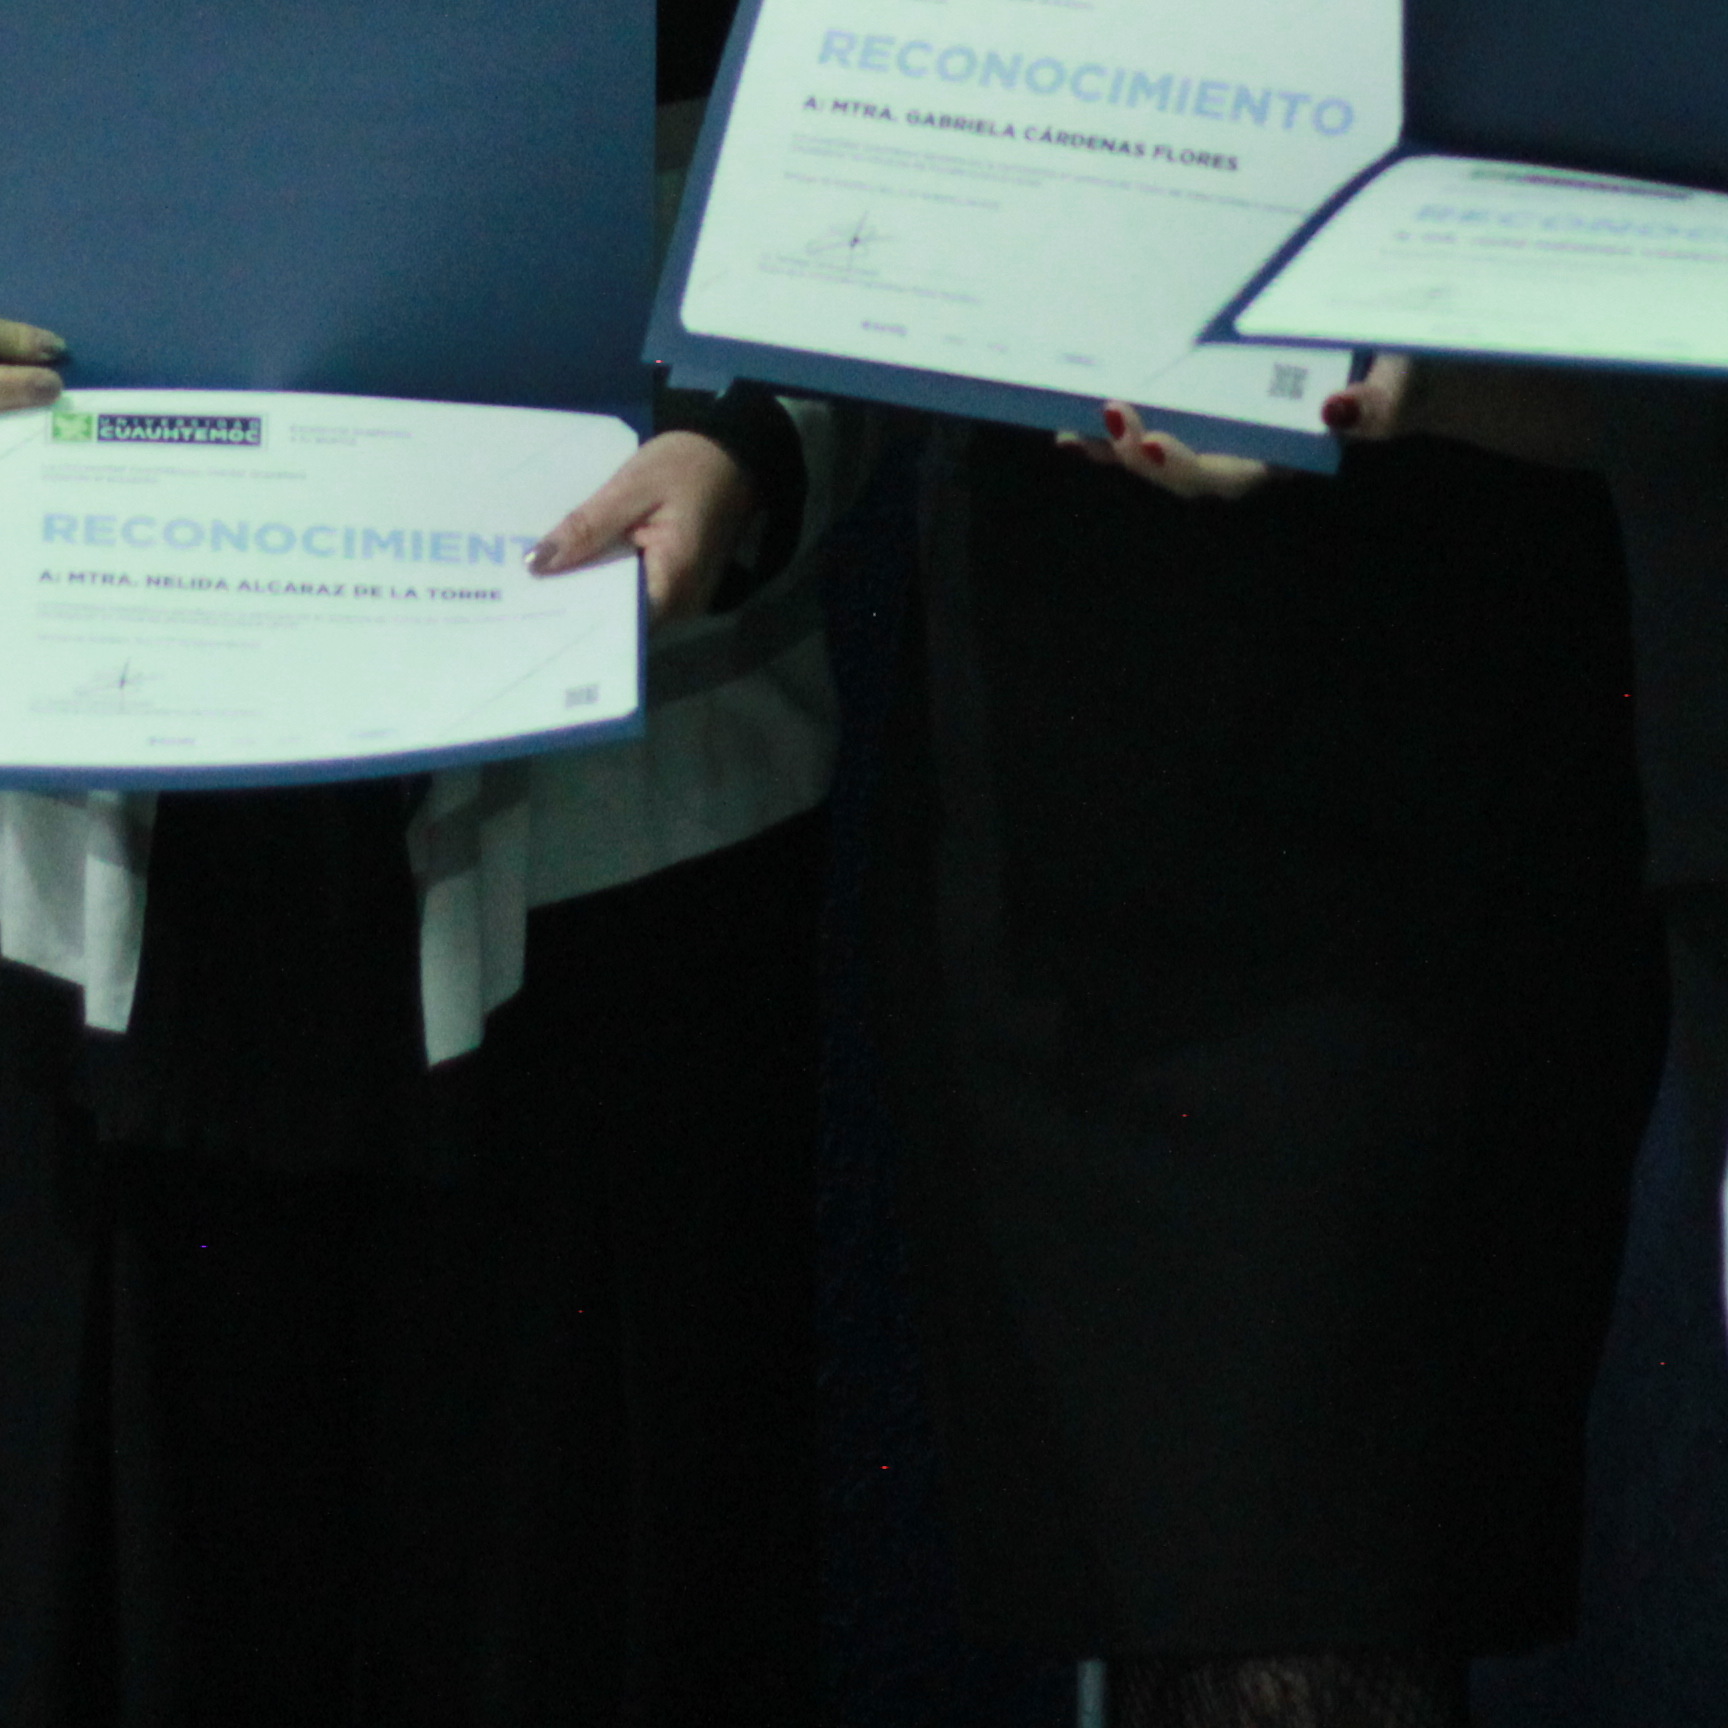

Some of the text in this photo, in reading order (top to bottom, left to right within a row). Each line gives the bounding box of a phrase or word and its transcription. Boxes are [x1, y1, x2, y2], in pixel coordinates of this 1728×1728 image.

[816, 28, 1357, 138] RECONOCIMIENTO
[831, 97, 899, 123] MTRA.
[904, 108, 1017, 141] GABRIELA
[1023, 123, 1146, 156] CÁRDENAS
[1152, 142, 1241, 172] FLORES
[99, 426, 262, 444] CUAUHTEMOC
[100, 416, 261, 430] UNIVERSIDAD
[43, 512, 540, 565] RECONOCIMIENT
[68, 571, 138, 588] MTRA.
[145, 574, 229, 593] NELIDA
[237, 580, 346, 598] ALCARAZ
[353, 586, 384, 600] DE
[389, 586, 420, 601] LA
[426, 587, 503, 603] TORRE
